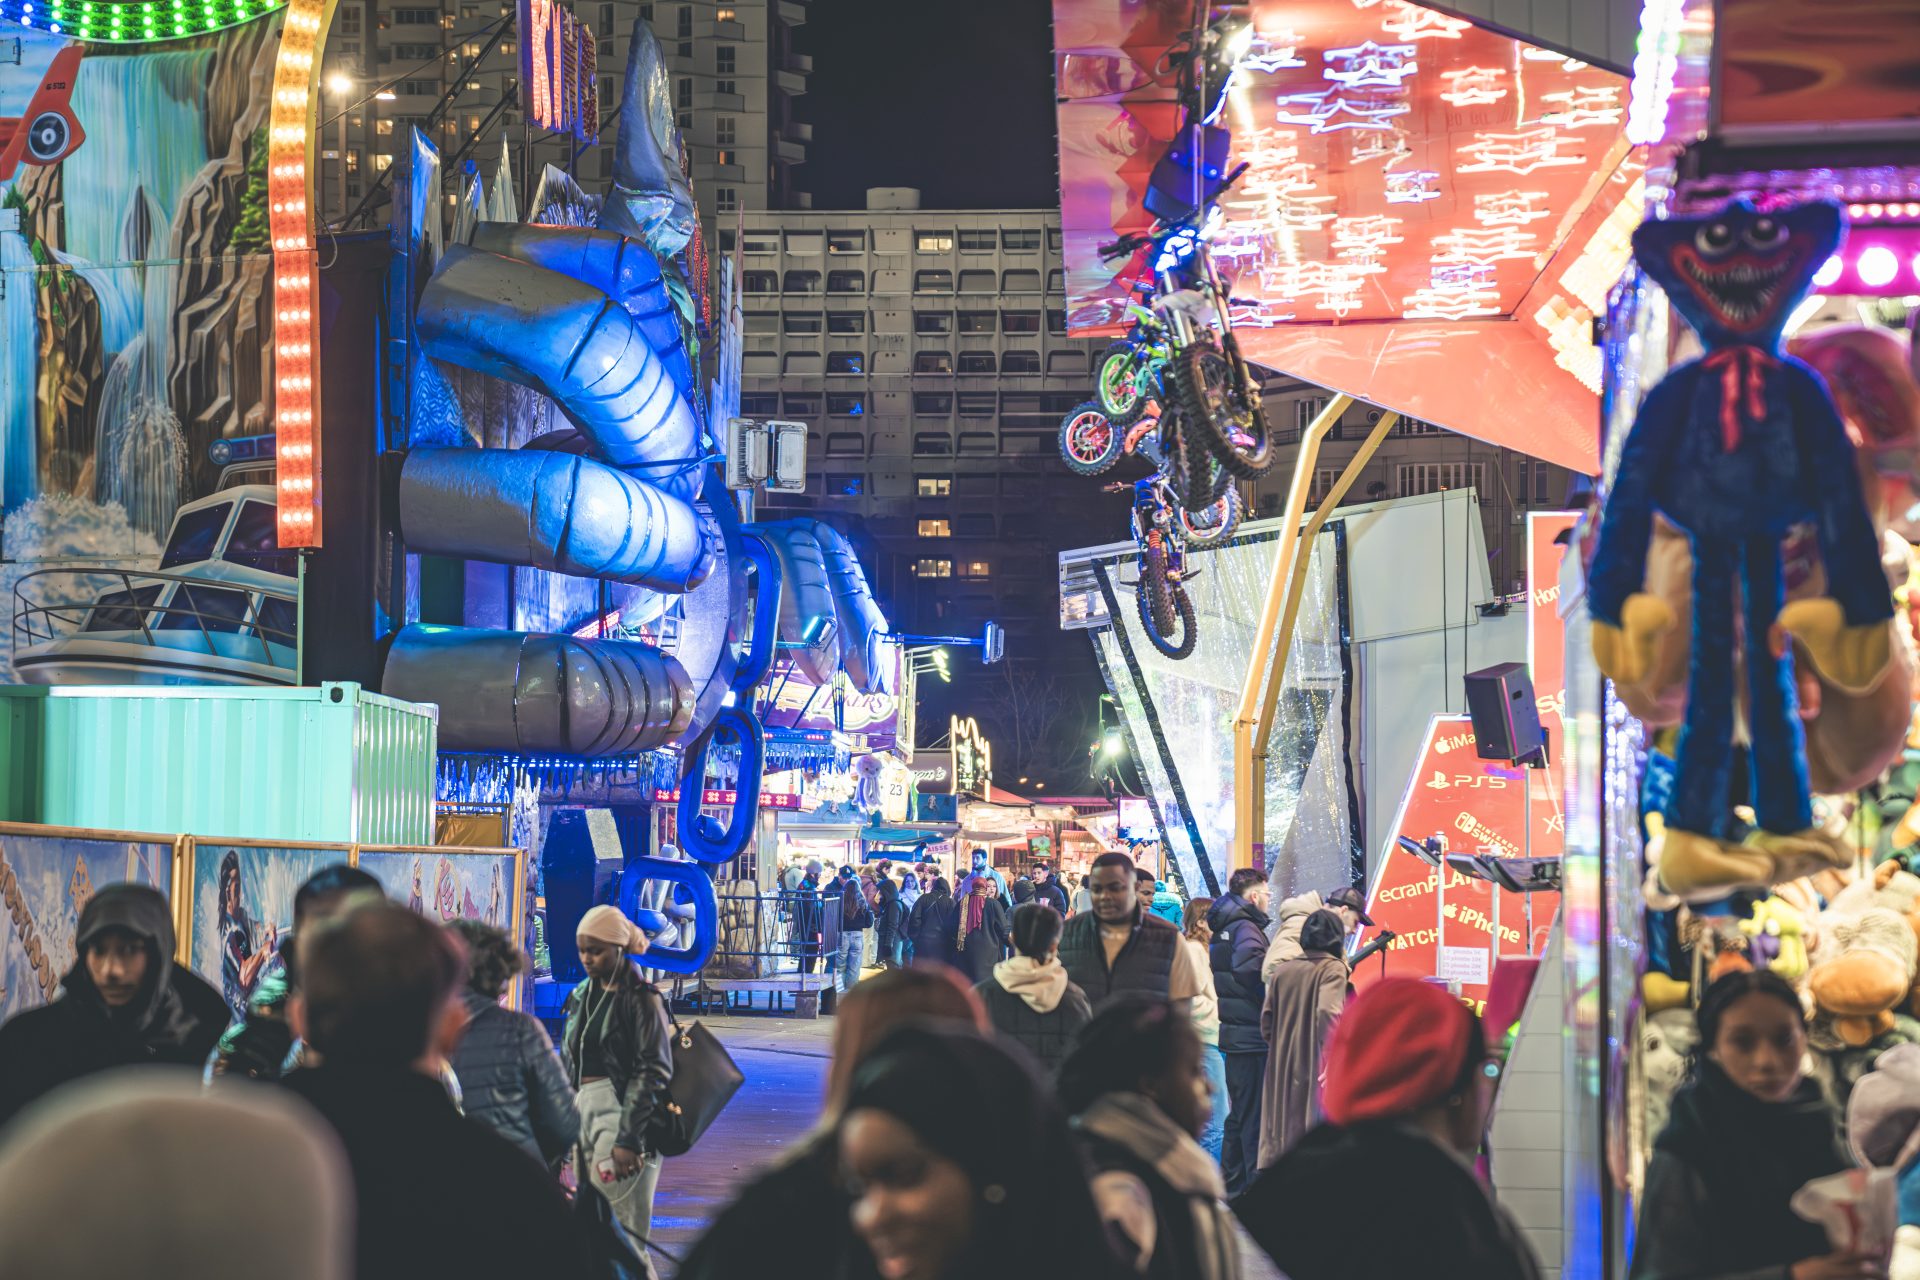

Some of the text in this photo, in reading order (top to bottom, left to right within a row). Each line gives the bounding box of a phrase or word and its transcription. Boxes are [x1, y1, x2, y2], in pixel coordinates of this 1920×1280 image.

[1449, 733, 1476, 750] iMa
[889, 783, 903, 796] 23
[1454, 774, 1507, 789] PS5
[1476, 822, 1520, 853] NINTENDO
[927, 843, 949, 854] AISSE
[1379, 871, 1472, 903] ecranPLA
[1459, 906, 1521, 944] iPhone
